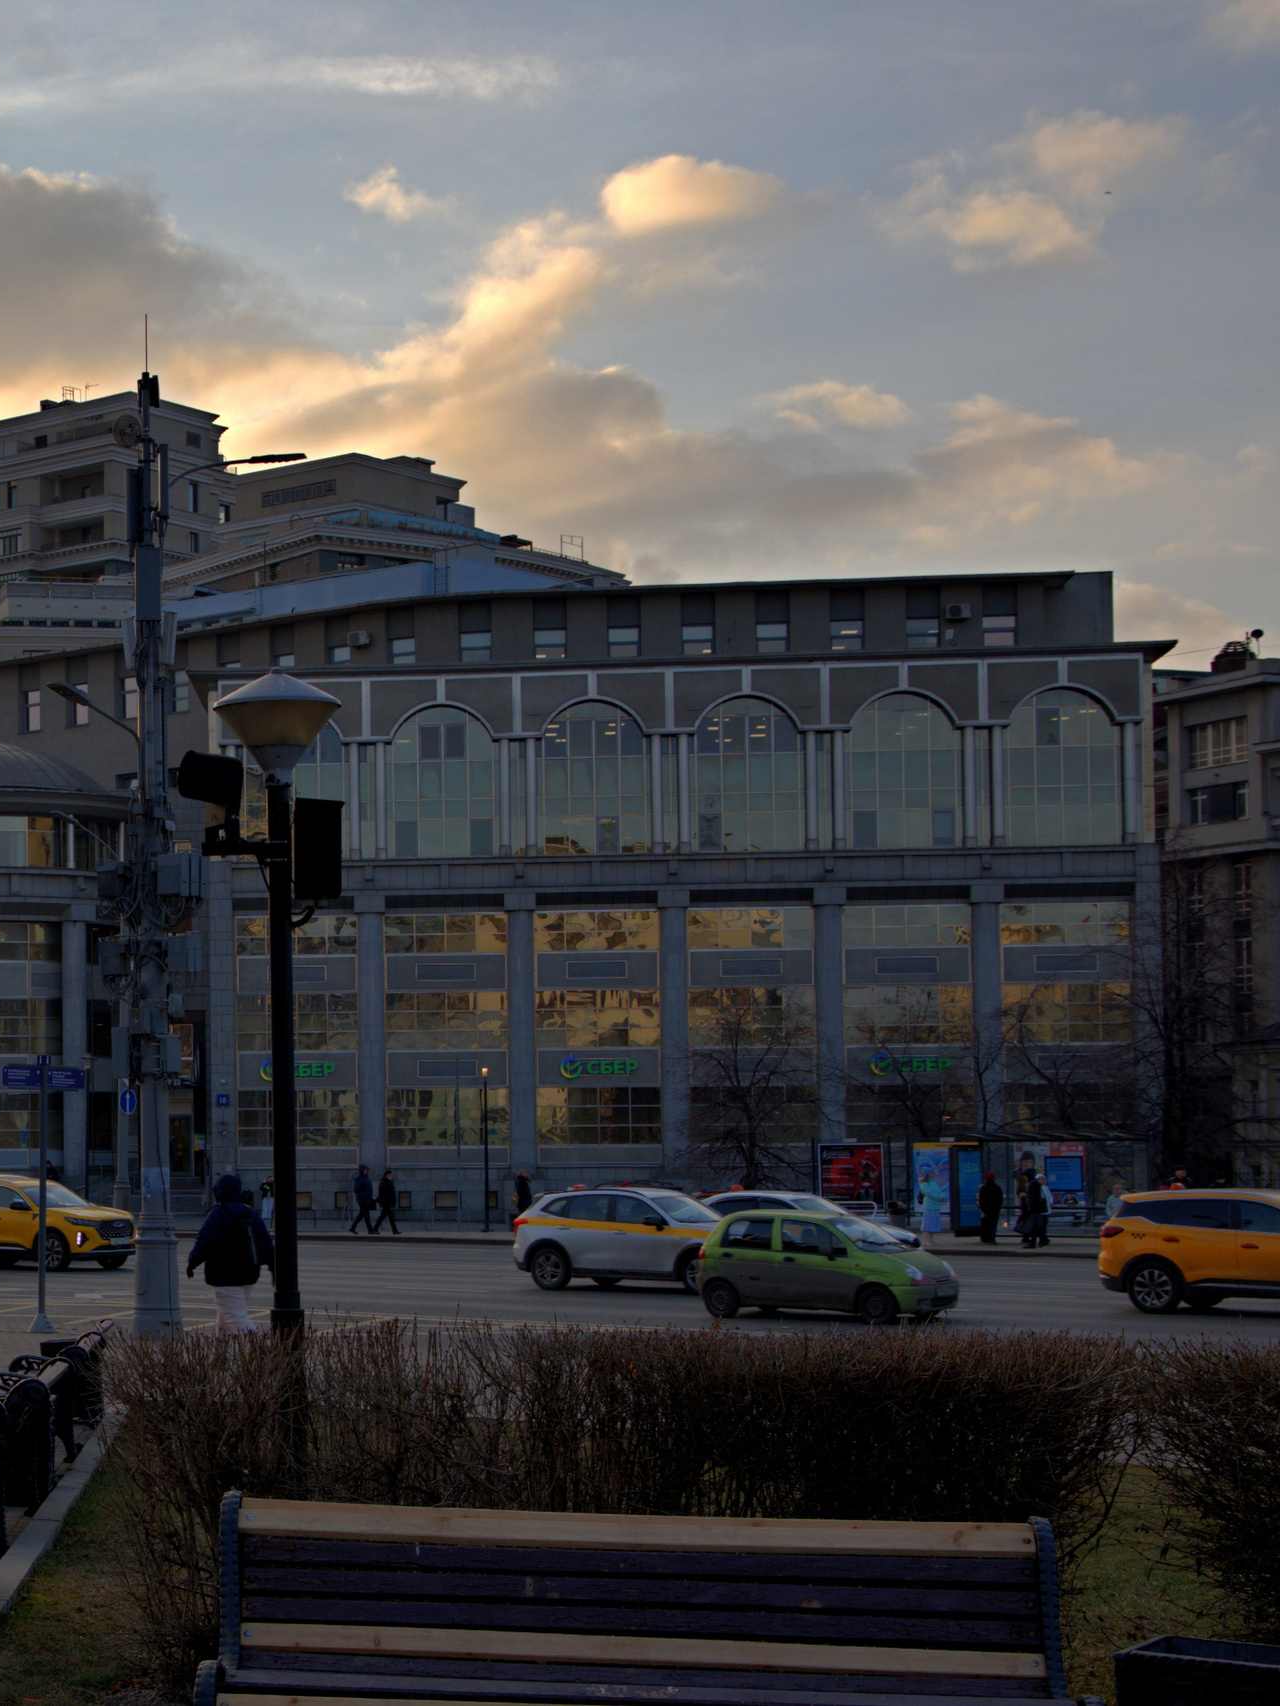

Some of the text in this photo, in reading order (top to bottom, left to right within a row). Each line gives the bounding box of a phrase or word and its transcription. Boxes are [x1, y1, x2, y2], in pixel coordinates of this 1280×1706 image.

[294, 1062, 336, 1077] БЕР
[587, 1060, 639, 1075] СБЕР
[898, 1057, 952, 1073] СБЕР
[219, 1096, 227, 1105] 18
